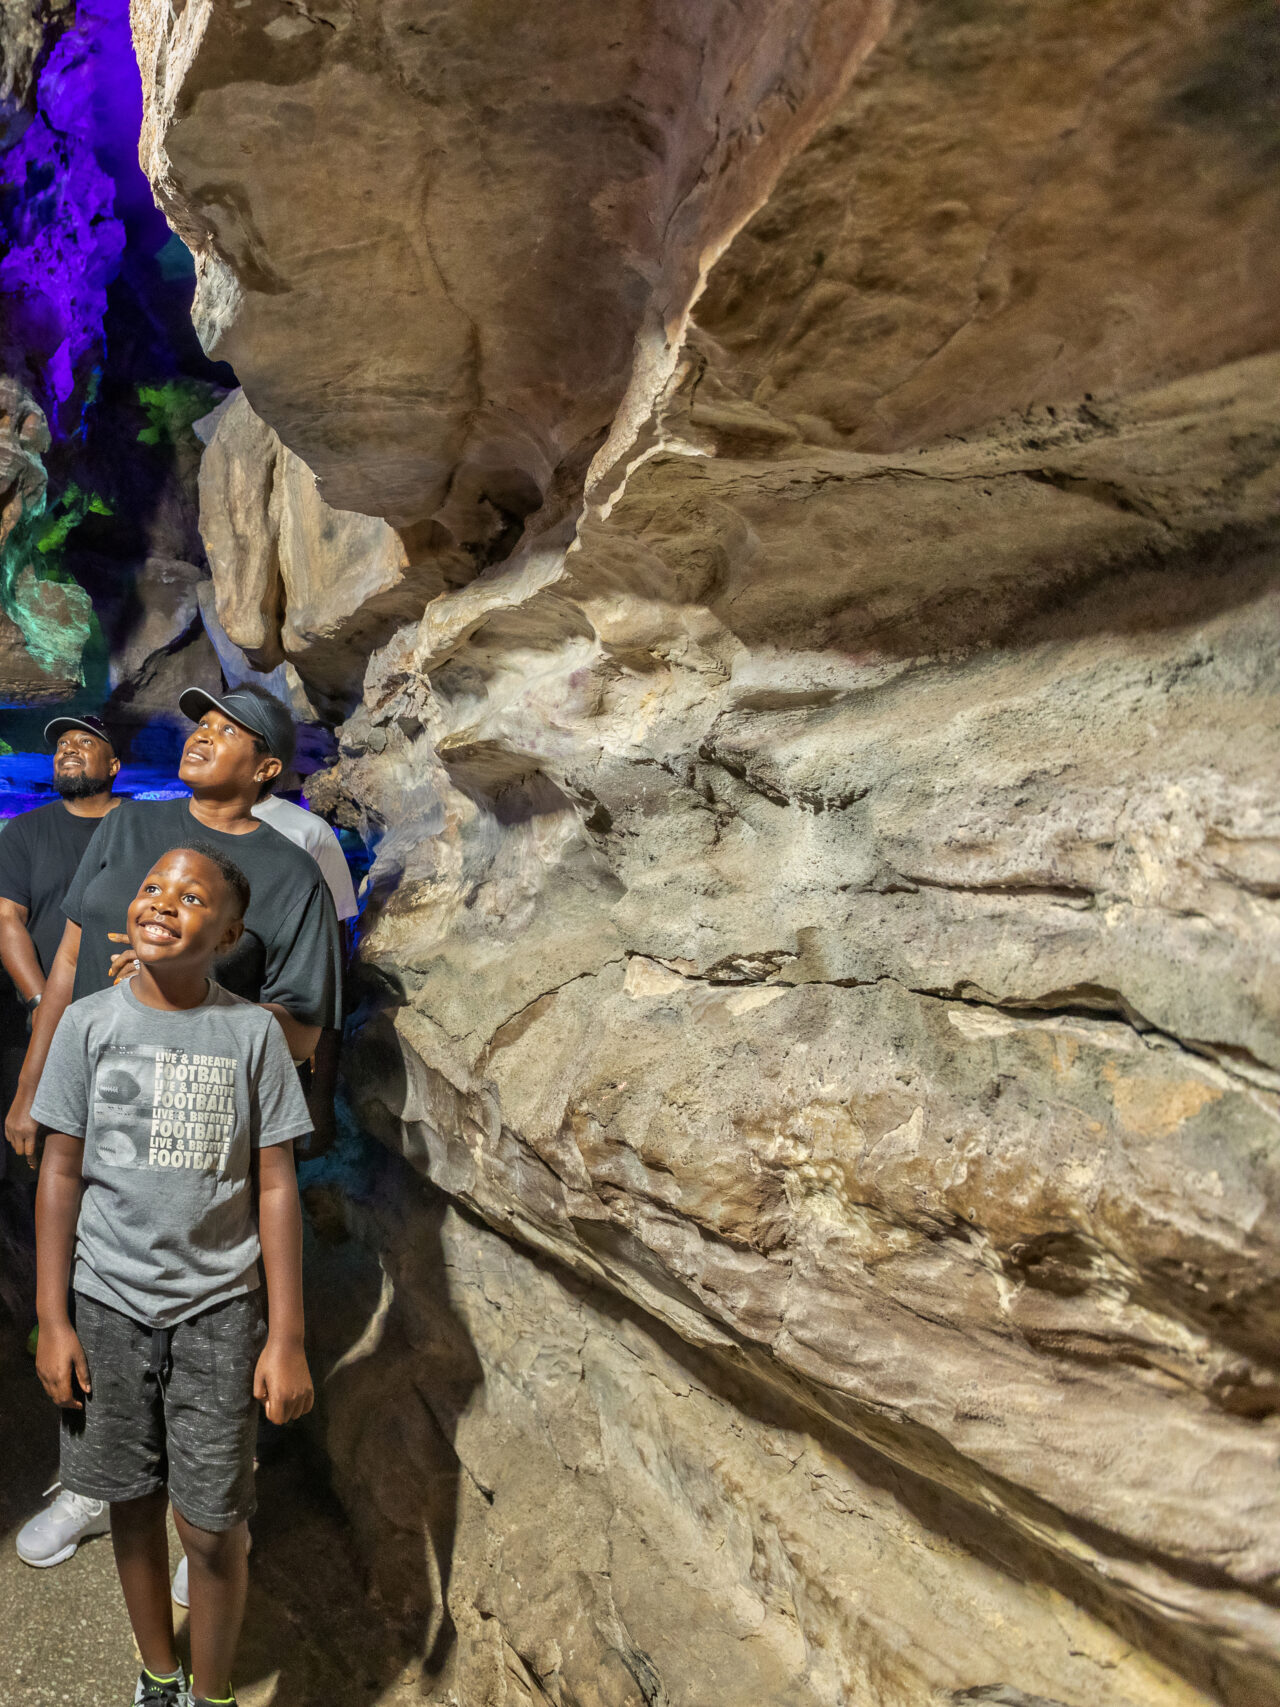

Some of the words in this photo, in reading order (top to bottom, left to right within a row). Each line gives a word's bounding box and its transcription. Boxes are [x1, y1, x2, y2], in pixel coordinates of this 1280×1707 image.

[156, 1052, 177, 1063] LIVE
[180, 1054, 189, 1064] &
[193, 1055, 237, 1069] BREATHE
[179, 1082, 188, 1092] &
[153, 1090, 235, 1114] FOOTBALL
[152, 1108, 174, 1120] LIVE
[178, 1111, 186, 1121] &
[150, 1137, 172, 1148] LIVE
[176, 1140, 184, 1150] &
